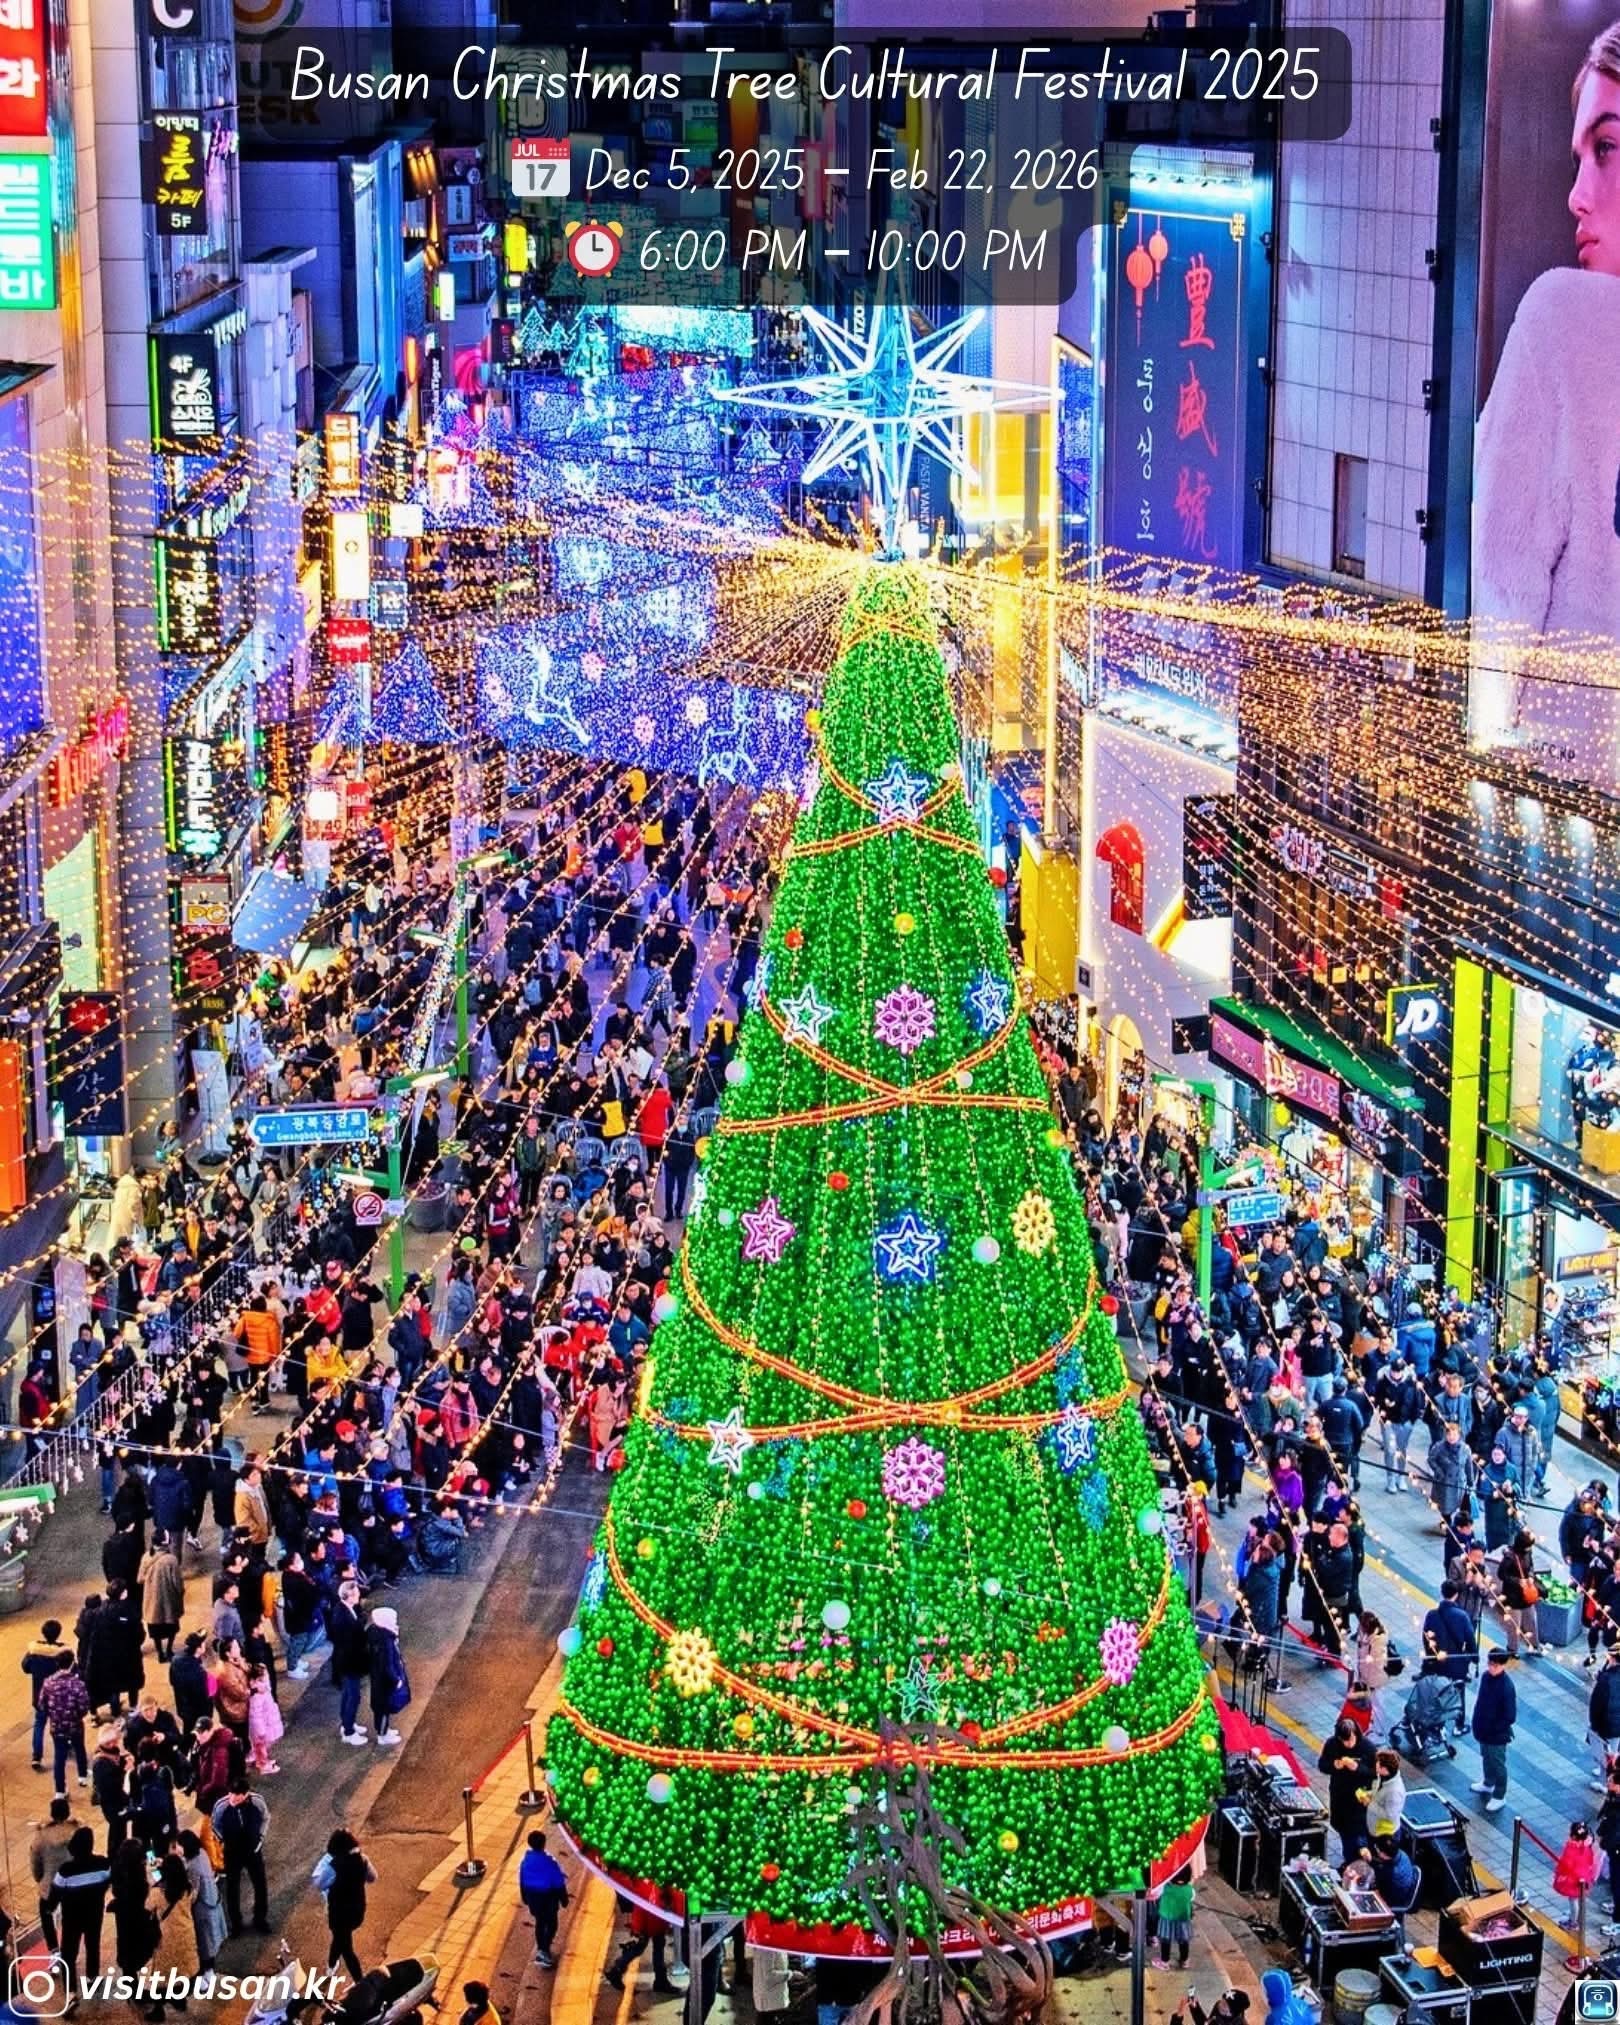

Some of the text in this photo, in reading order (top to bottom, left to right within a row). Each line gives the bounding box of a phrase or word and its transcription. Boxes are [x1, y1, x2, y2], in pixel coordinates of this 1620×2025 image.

[170, 212, 192, 228] 5F
[187, 905, 228, 923] PC
[1395, 998, 1438, 1036] JD
[1479, 1953, 1534, 1970] LIGHTING
